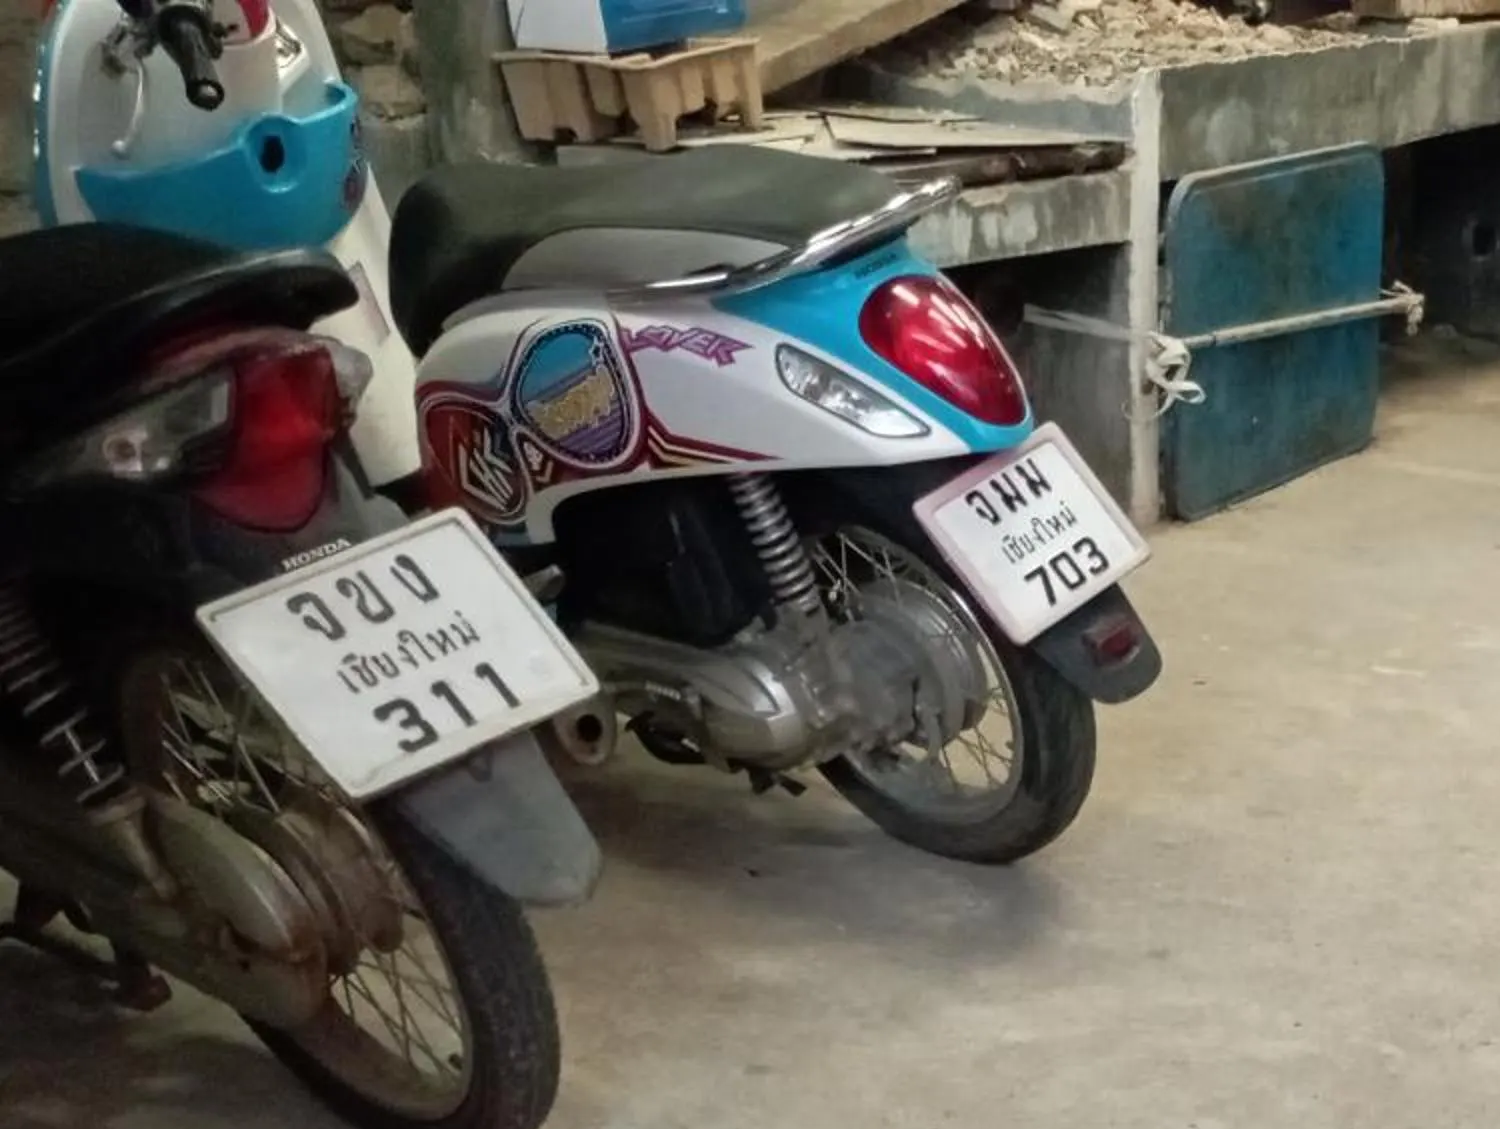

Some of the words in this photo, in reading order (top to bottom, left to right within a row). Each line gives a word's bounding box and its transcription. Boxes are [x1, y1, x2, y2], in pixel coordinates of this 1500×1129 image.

[281, 538, 351, 571] HONDA
[1002, 500, 1077, 564] เชียงใหม่
[1024, 535, 1110, 606] 703
[287, 554, 440, 641] จขง
[337, 610, 480, 694] เชียงใหม่
[373, 662, 521, 753] 311
